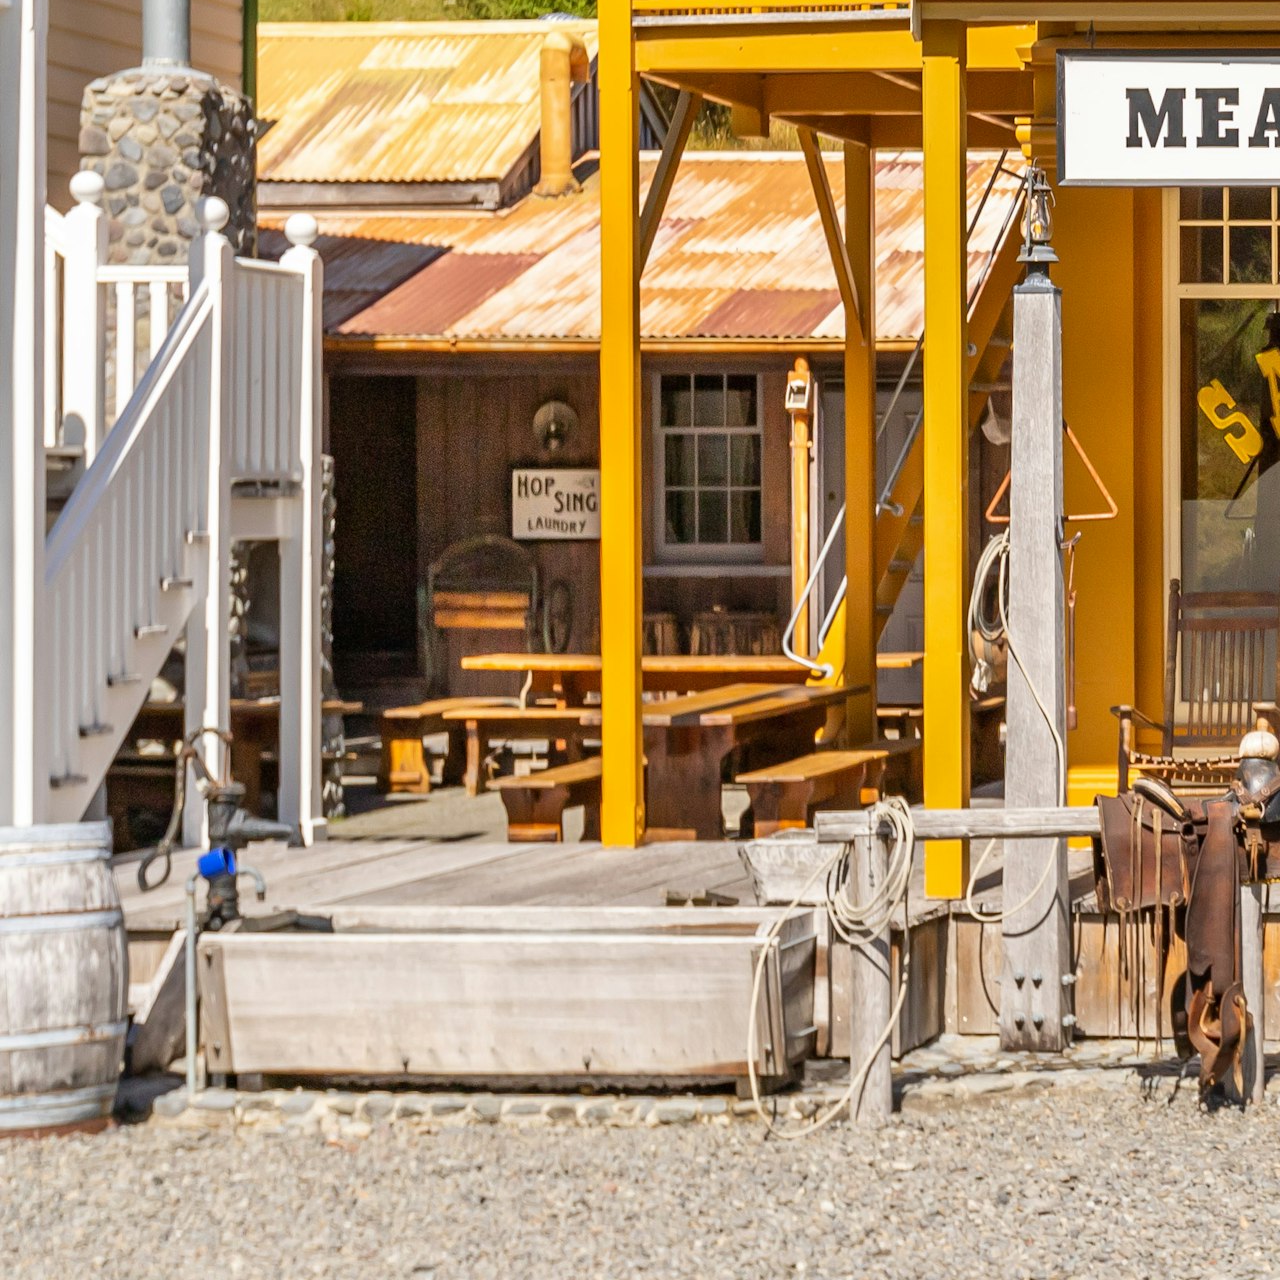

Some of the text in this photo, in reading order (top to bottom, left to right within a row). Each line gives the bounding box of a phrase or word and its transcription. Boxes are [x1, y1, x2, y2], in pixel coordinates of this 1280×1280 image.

[517, 474, 555, 498] HOP
[554, 491, 597, 513] SING
[527, 516, 586, 533] LAUNDRY
